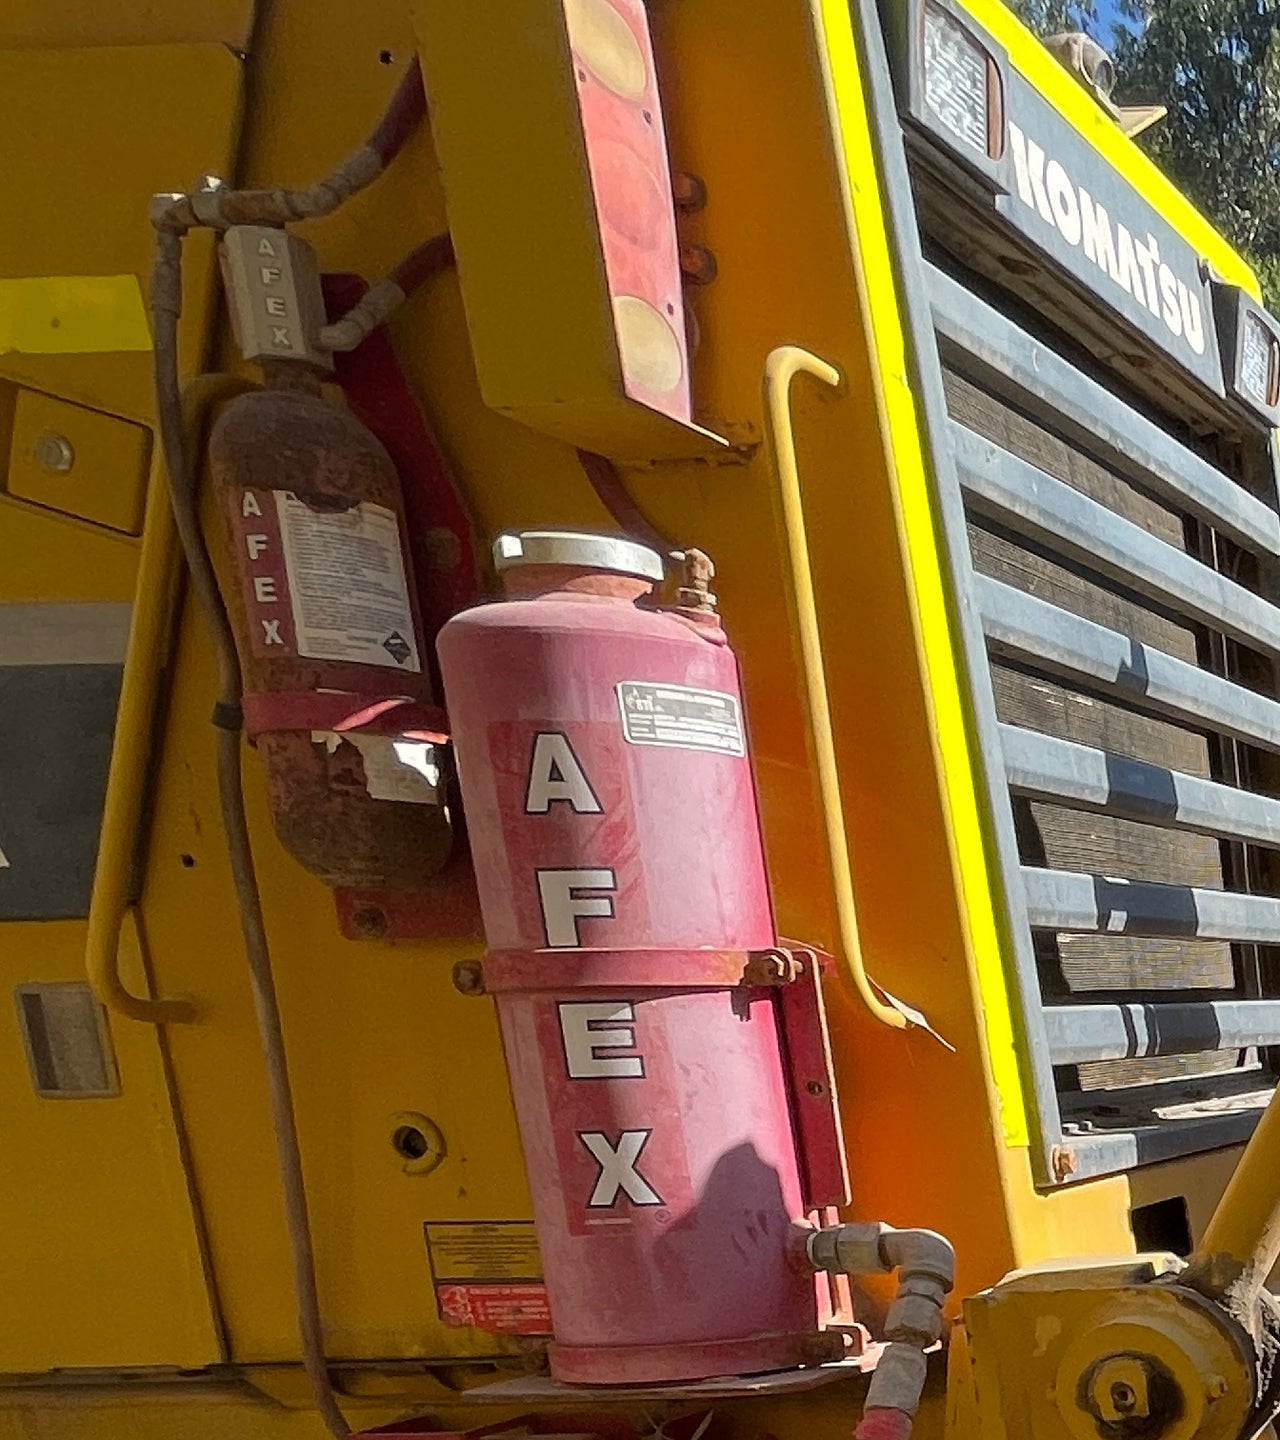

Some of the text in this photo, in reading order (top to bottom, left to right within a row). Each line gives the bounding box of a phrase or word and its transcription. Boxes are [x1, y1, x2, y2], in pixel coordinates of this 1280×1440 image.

[258, 238, 294, 350] AFEX
[1009, 122, 1205, 356] KOMATSU
[242, 491, 285, 646] AFEX
[523, 730, 665, 1210] AFEX
